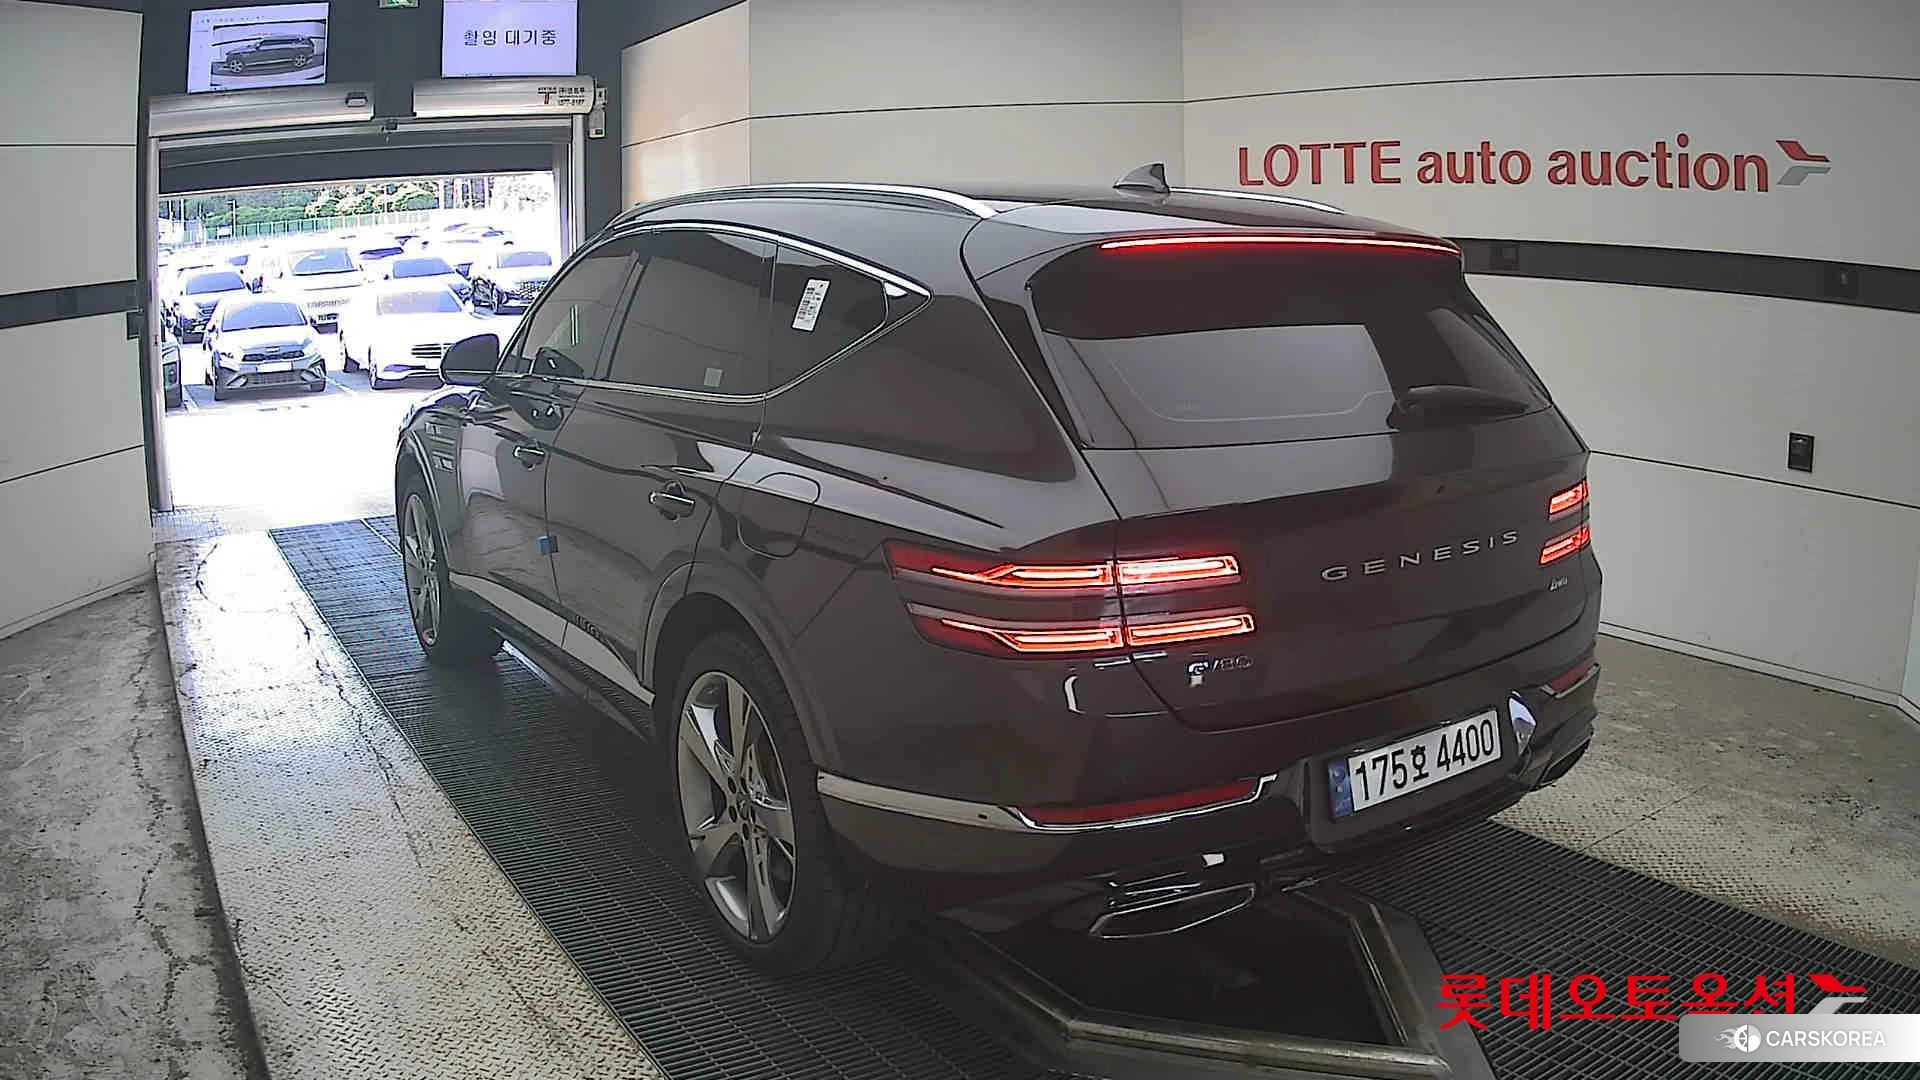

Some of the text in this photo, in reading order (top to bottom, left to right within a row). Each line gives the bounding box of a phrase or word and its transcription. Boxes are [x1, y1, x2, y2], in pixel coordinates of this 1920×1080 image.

[505, 30, 556, 46] 대기중
[1239, 133, 1769, 193] LOTTE auto auction
[1321, 531, 1518, 581] GENESIS
[1355, 719, 1495, 801] 175호 4400
